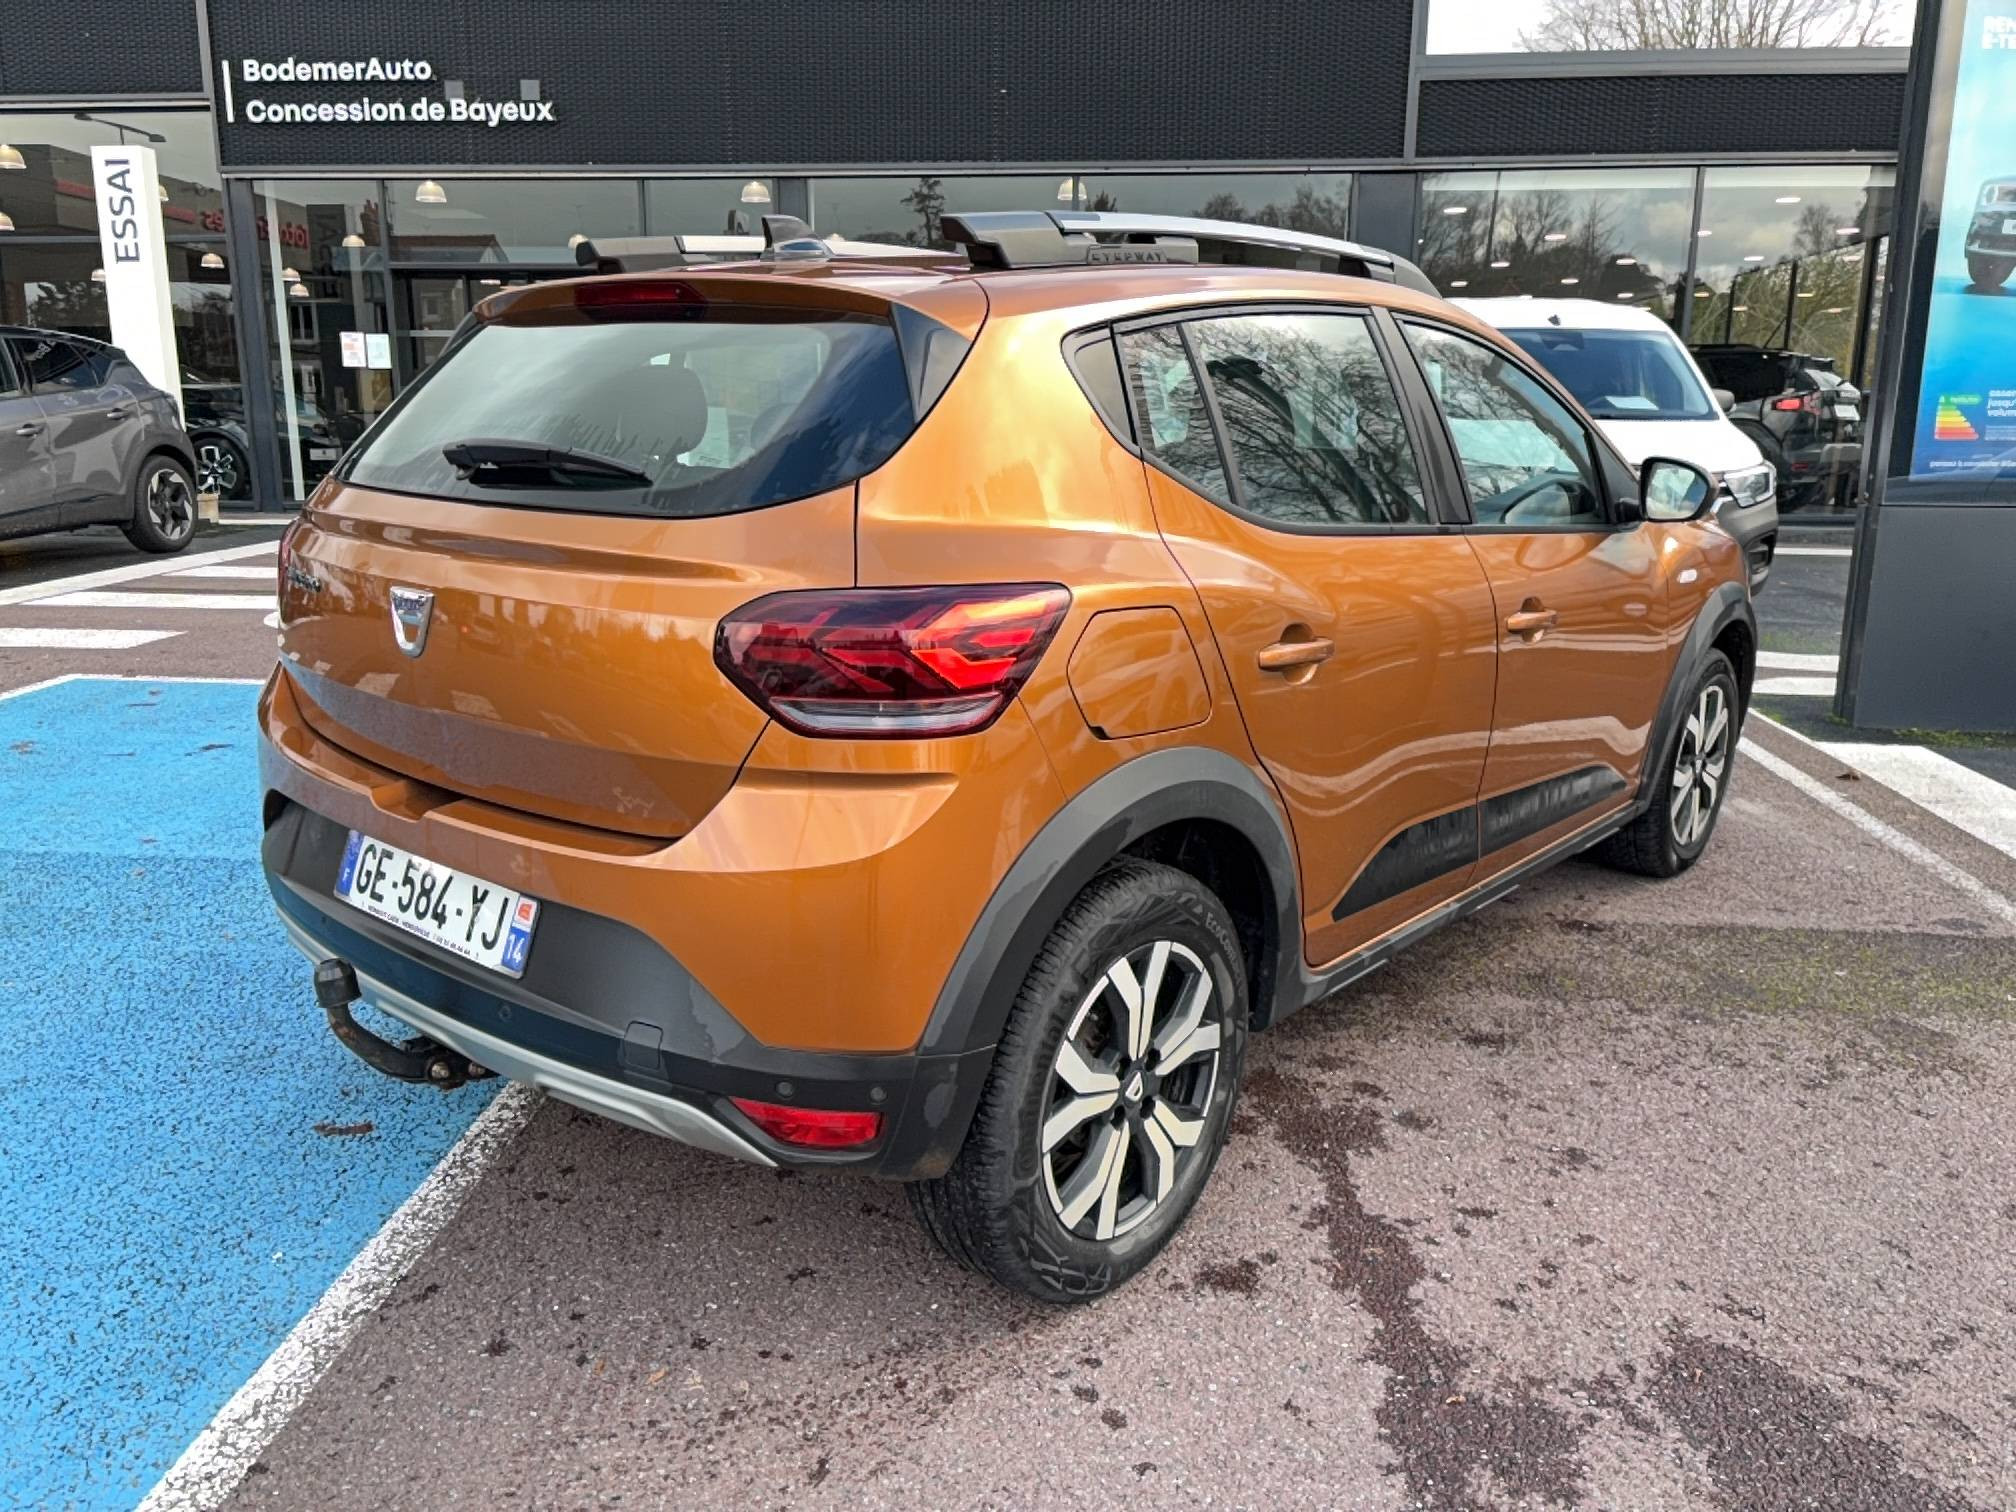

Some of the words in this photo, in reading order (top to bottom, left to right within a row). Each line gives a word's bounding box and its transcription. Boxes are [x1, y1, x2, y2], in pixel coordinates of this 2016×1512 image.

[242, 57, 433, 82] BodemerAuto
[246, 97, 405, 123] Concession
[410, 96, 445, 122] de
[450, 98, 553, 127] Bayeux
[104, 158, 141, 265] ESSAI
[356, 843, 509, 950] GE-584-YJ
[506, 932, 525, 963] 14
